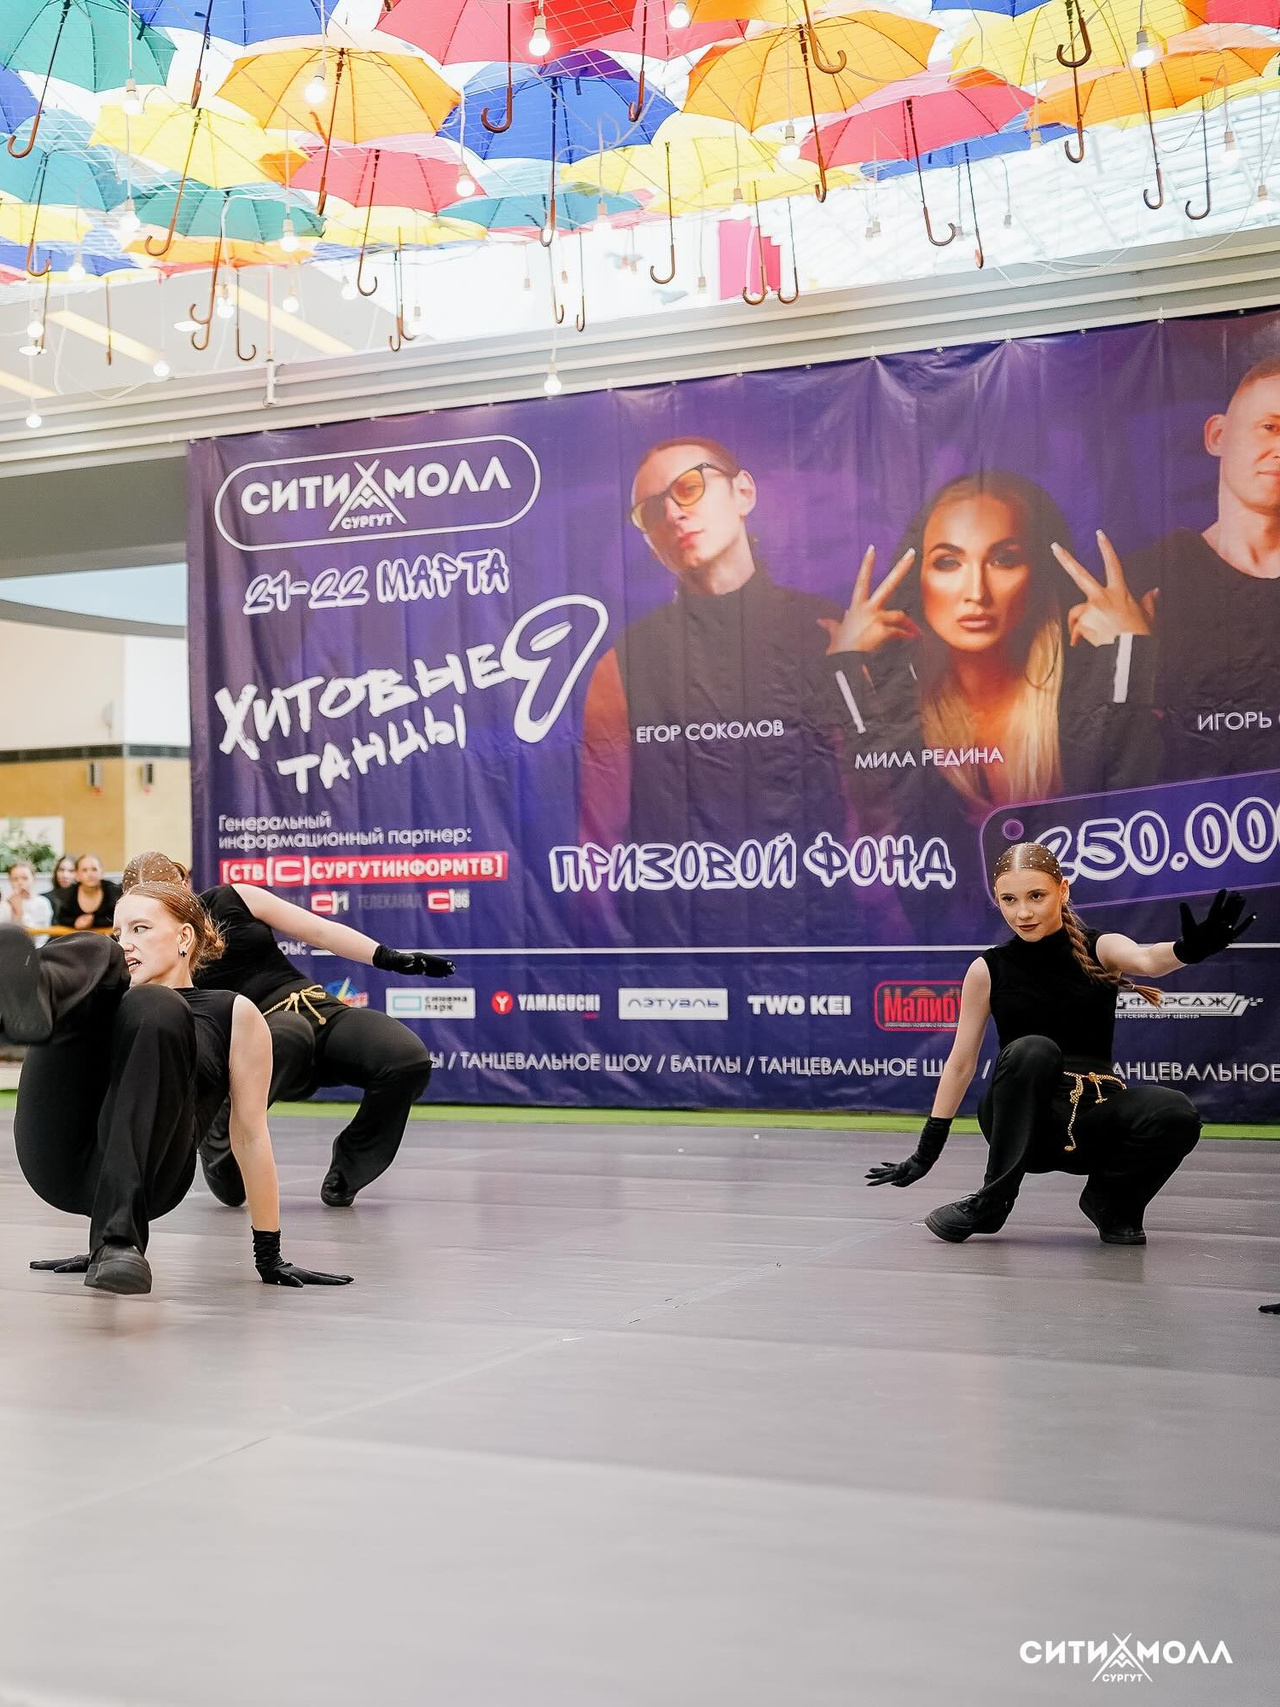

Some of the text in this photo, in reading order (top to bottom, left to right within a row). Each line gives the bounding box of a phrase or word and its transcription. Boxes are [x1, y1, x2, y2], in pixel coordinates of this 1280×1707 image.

[240, 456, 512, 516] СИТИ МОЛЛ
[340, 512, 395, 530] СУРГУТ
[242, 548, 510, 615] 21-22 МАРТА
[214, 643, 508, 761] ХИТОВЫЕ
[636, 719, 785, 744] ЕГОР СОКОЛОВ
[1197, 711, 1272, 732] ИГОРЬ
[276, 704, 467, 795] ТАНЦЫ
[854, 746, 1004, 770] МИЛА РЕДИНА
[219, 811, 332, 833] Генеральный
[219, 827, 473, 851] информационный партнер:
[1032, 796, 1280, 886] 250.00
[549, 831, 957, 893] ПРИЗОВОЙ ФОНД
[518, 994, 600, 1011] YAMAGUCHI
[747, 995, 851, 1016] TWO KEI
[1129, 997, 1228, 1007] ФРСАЖ
[460, 1052, 600, 1071] ТАНЦЕВАЛЬНОЕ
[605, 1054, 652, 1073] ШОУ
[670, 1054, 741, 1074] БАТТЛЫ
[760, 1056, 917, 1077] ТАНЦЕВАЛЬНОЕ
[1113, 1062, 1280, 1083] АНЦЕВАЛЬНОЕ
